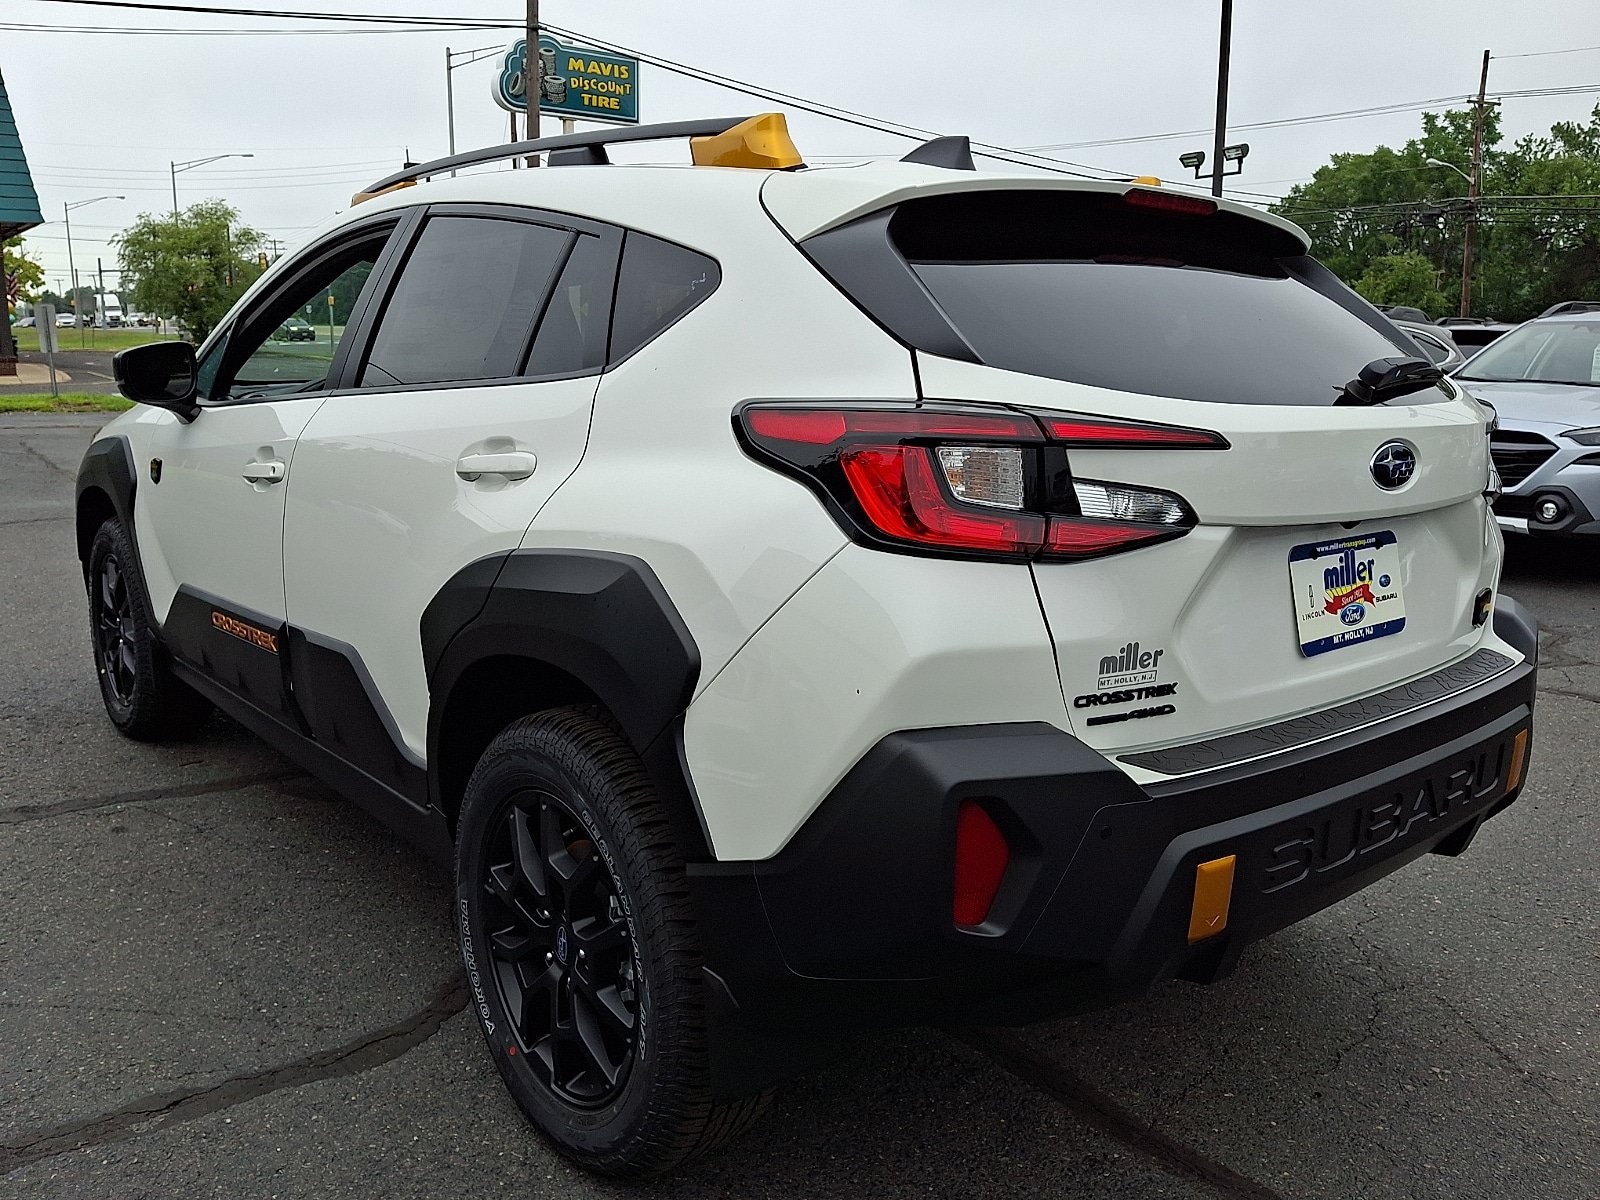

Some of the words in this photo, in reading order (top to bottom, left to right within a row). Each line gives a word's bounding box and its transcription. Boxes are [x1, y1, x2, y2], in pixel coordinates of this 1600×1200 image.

[568, 57, 629, 79] MAVIS
[570, 76, 632, 96] DISCOUNT
[581, 93, 621, 110] TIRE
[1323, 549, 1375, 590] miller
[1375, 592, 1398, 603] SUBARU
[1302, 609, 1326, 621] LINCOLN
[211, 611, 278, 653] CROSSTREK
[1333, 635, 1344, 645] MT.
[1365, 626, 1374, 636] NJ
[1099, 642, 1164, 675] miller
[1100, 679, 1112, 687] MT.
[1142, 673, 1155, 681] N.J.
[1074, 682, 1178, 708] CROSSTREK
[1127, 704, 1177, 720] AWD
[1262, 744, 1505, 894] SUBARU
[460, 899, 495, 1035] YOKOHAMA
